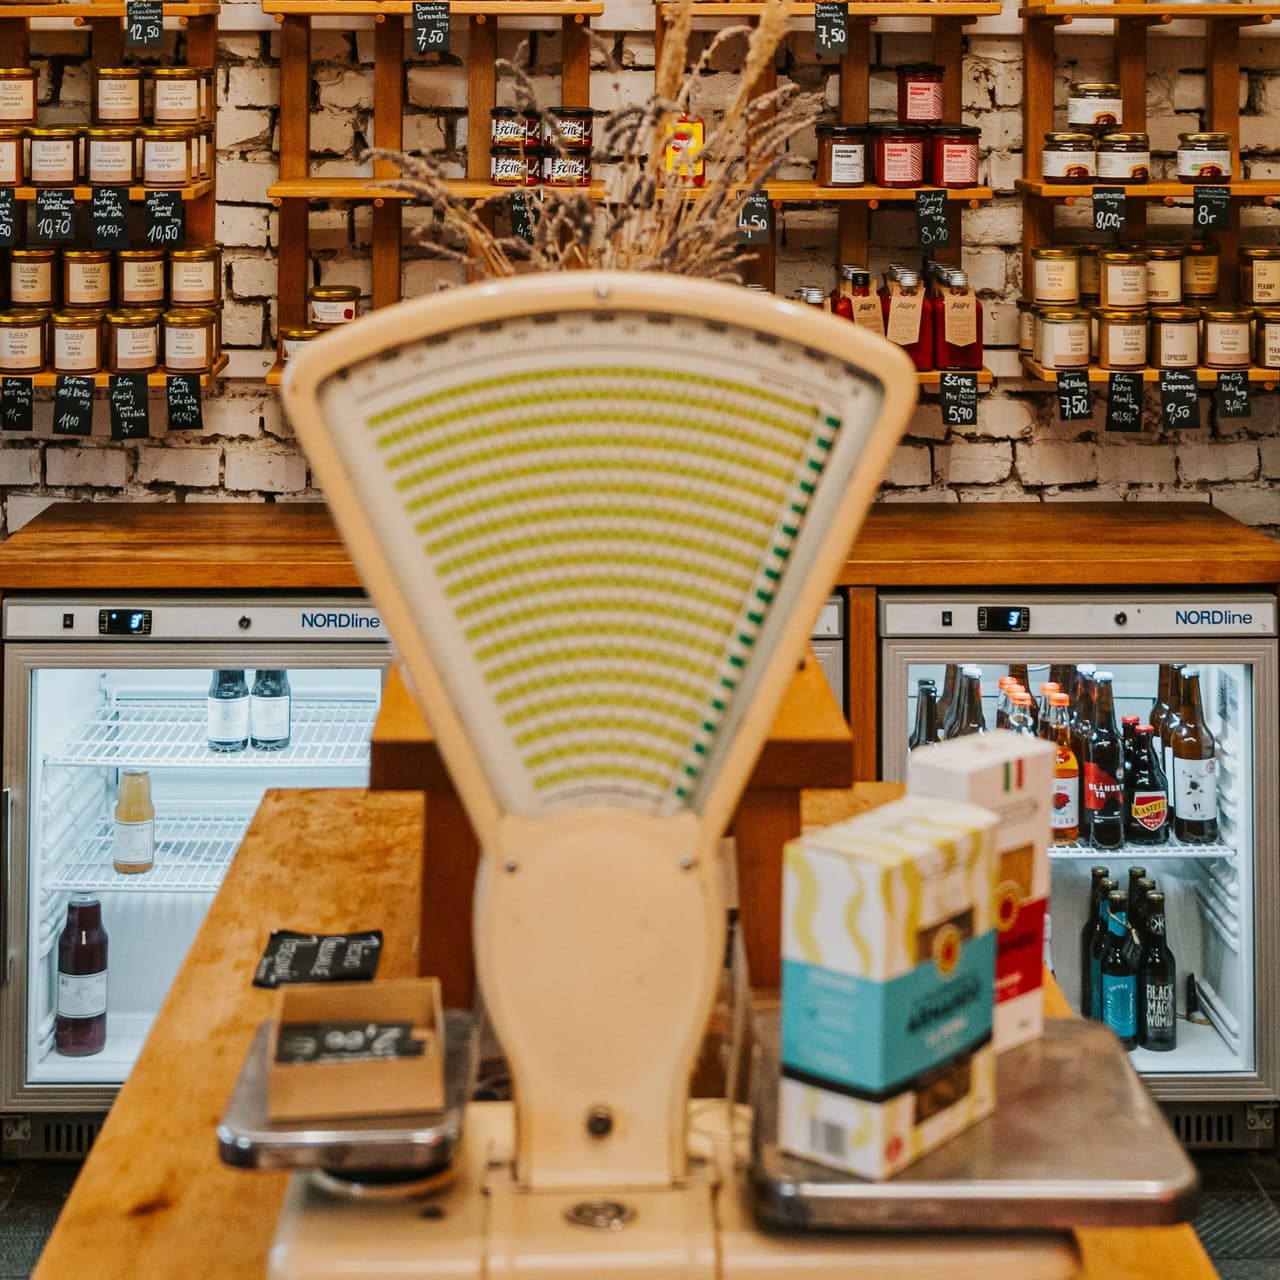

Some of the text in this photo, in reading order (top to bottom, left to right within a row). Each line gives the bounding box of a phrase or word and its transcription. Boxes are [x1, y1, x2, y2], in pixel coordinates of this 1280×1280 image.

[130, 24, 159, 44] 12,50
[417, 28, 444, 51] 7,50
[817, 25, 845, 48] 7,50
[37, 219, 70, 239] 10,70
[147, 225, 178, 243] 10,50
[1161, 383, 1194, 392] Espresso
[948, 406, 973, 423] 5,90
[1166, 403, 1190, 424] 9,50
[301, 613, 381, 629] NORDline
[1175, 610, 1253, 625] NORDline
[1146, 984, 1173, 1000] BLACK
